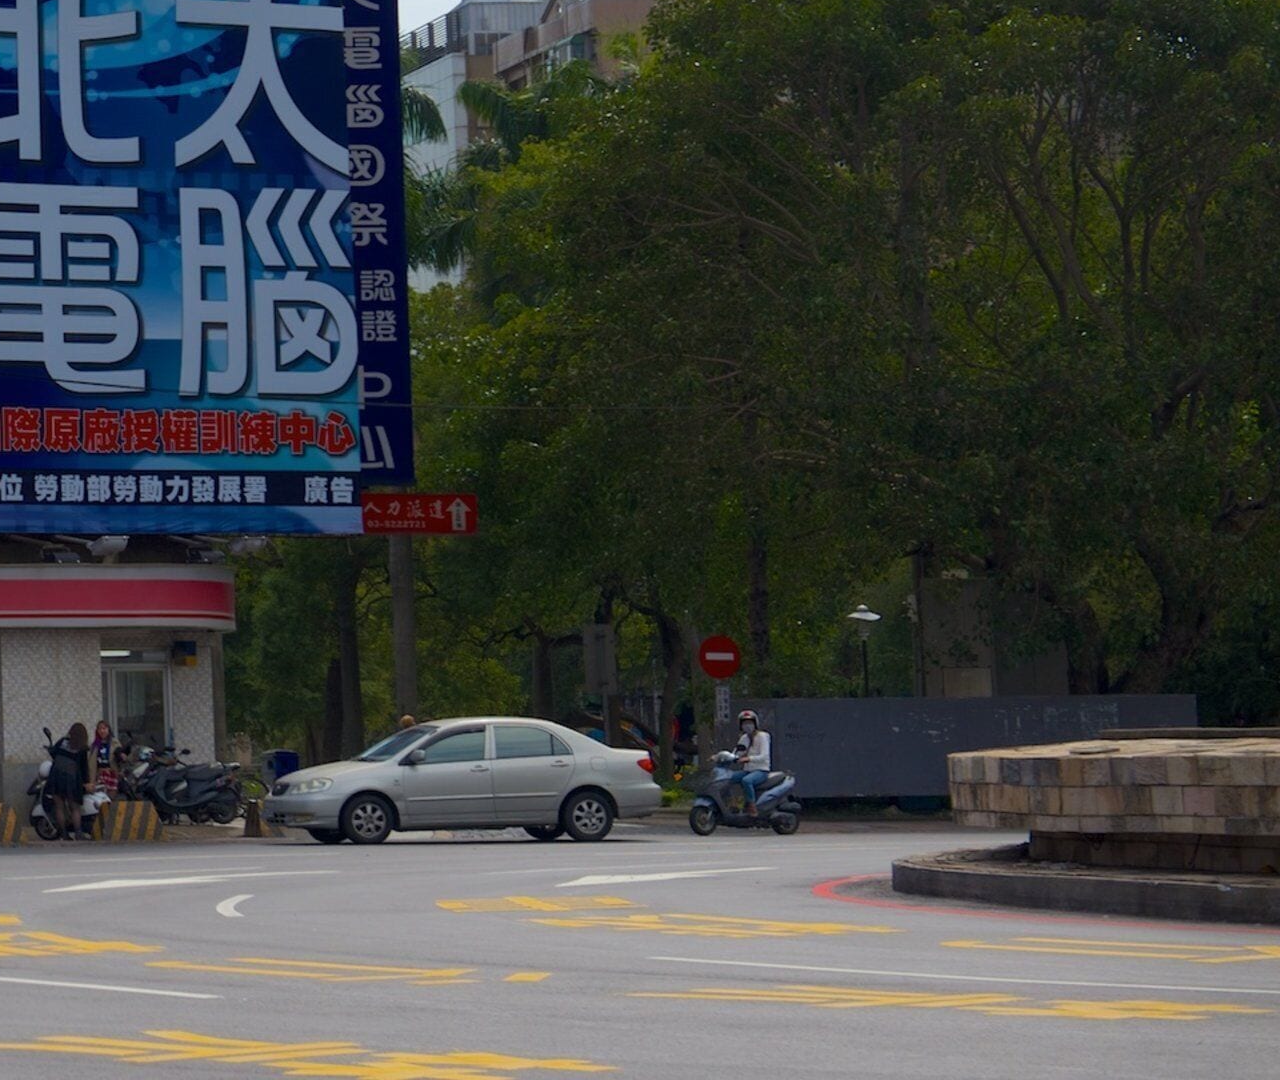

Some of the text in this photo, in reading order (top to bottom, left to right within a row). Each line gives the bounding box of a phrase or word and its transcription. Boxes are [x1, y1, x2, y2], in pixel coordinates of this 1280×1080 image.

[34, 473, 269, 505] 勞動部勞動力發展署
[304, 475, 355, 505] 廣告
